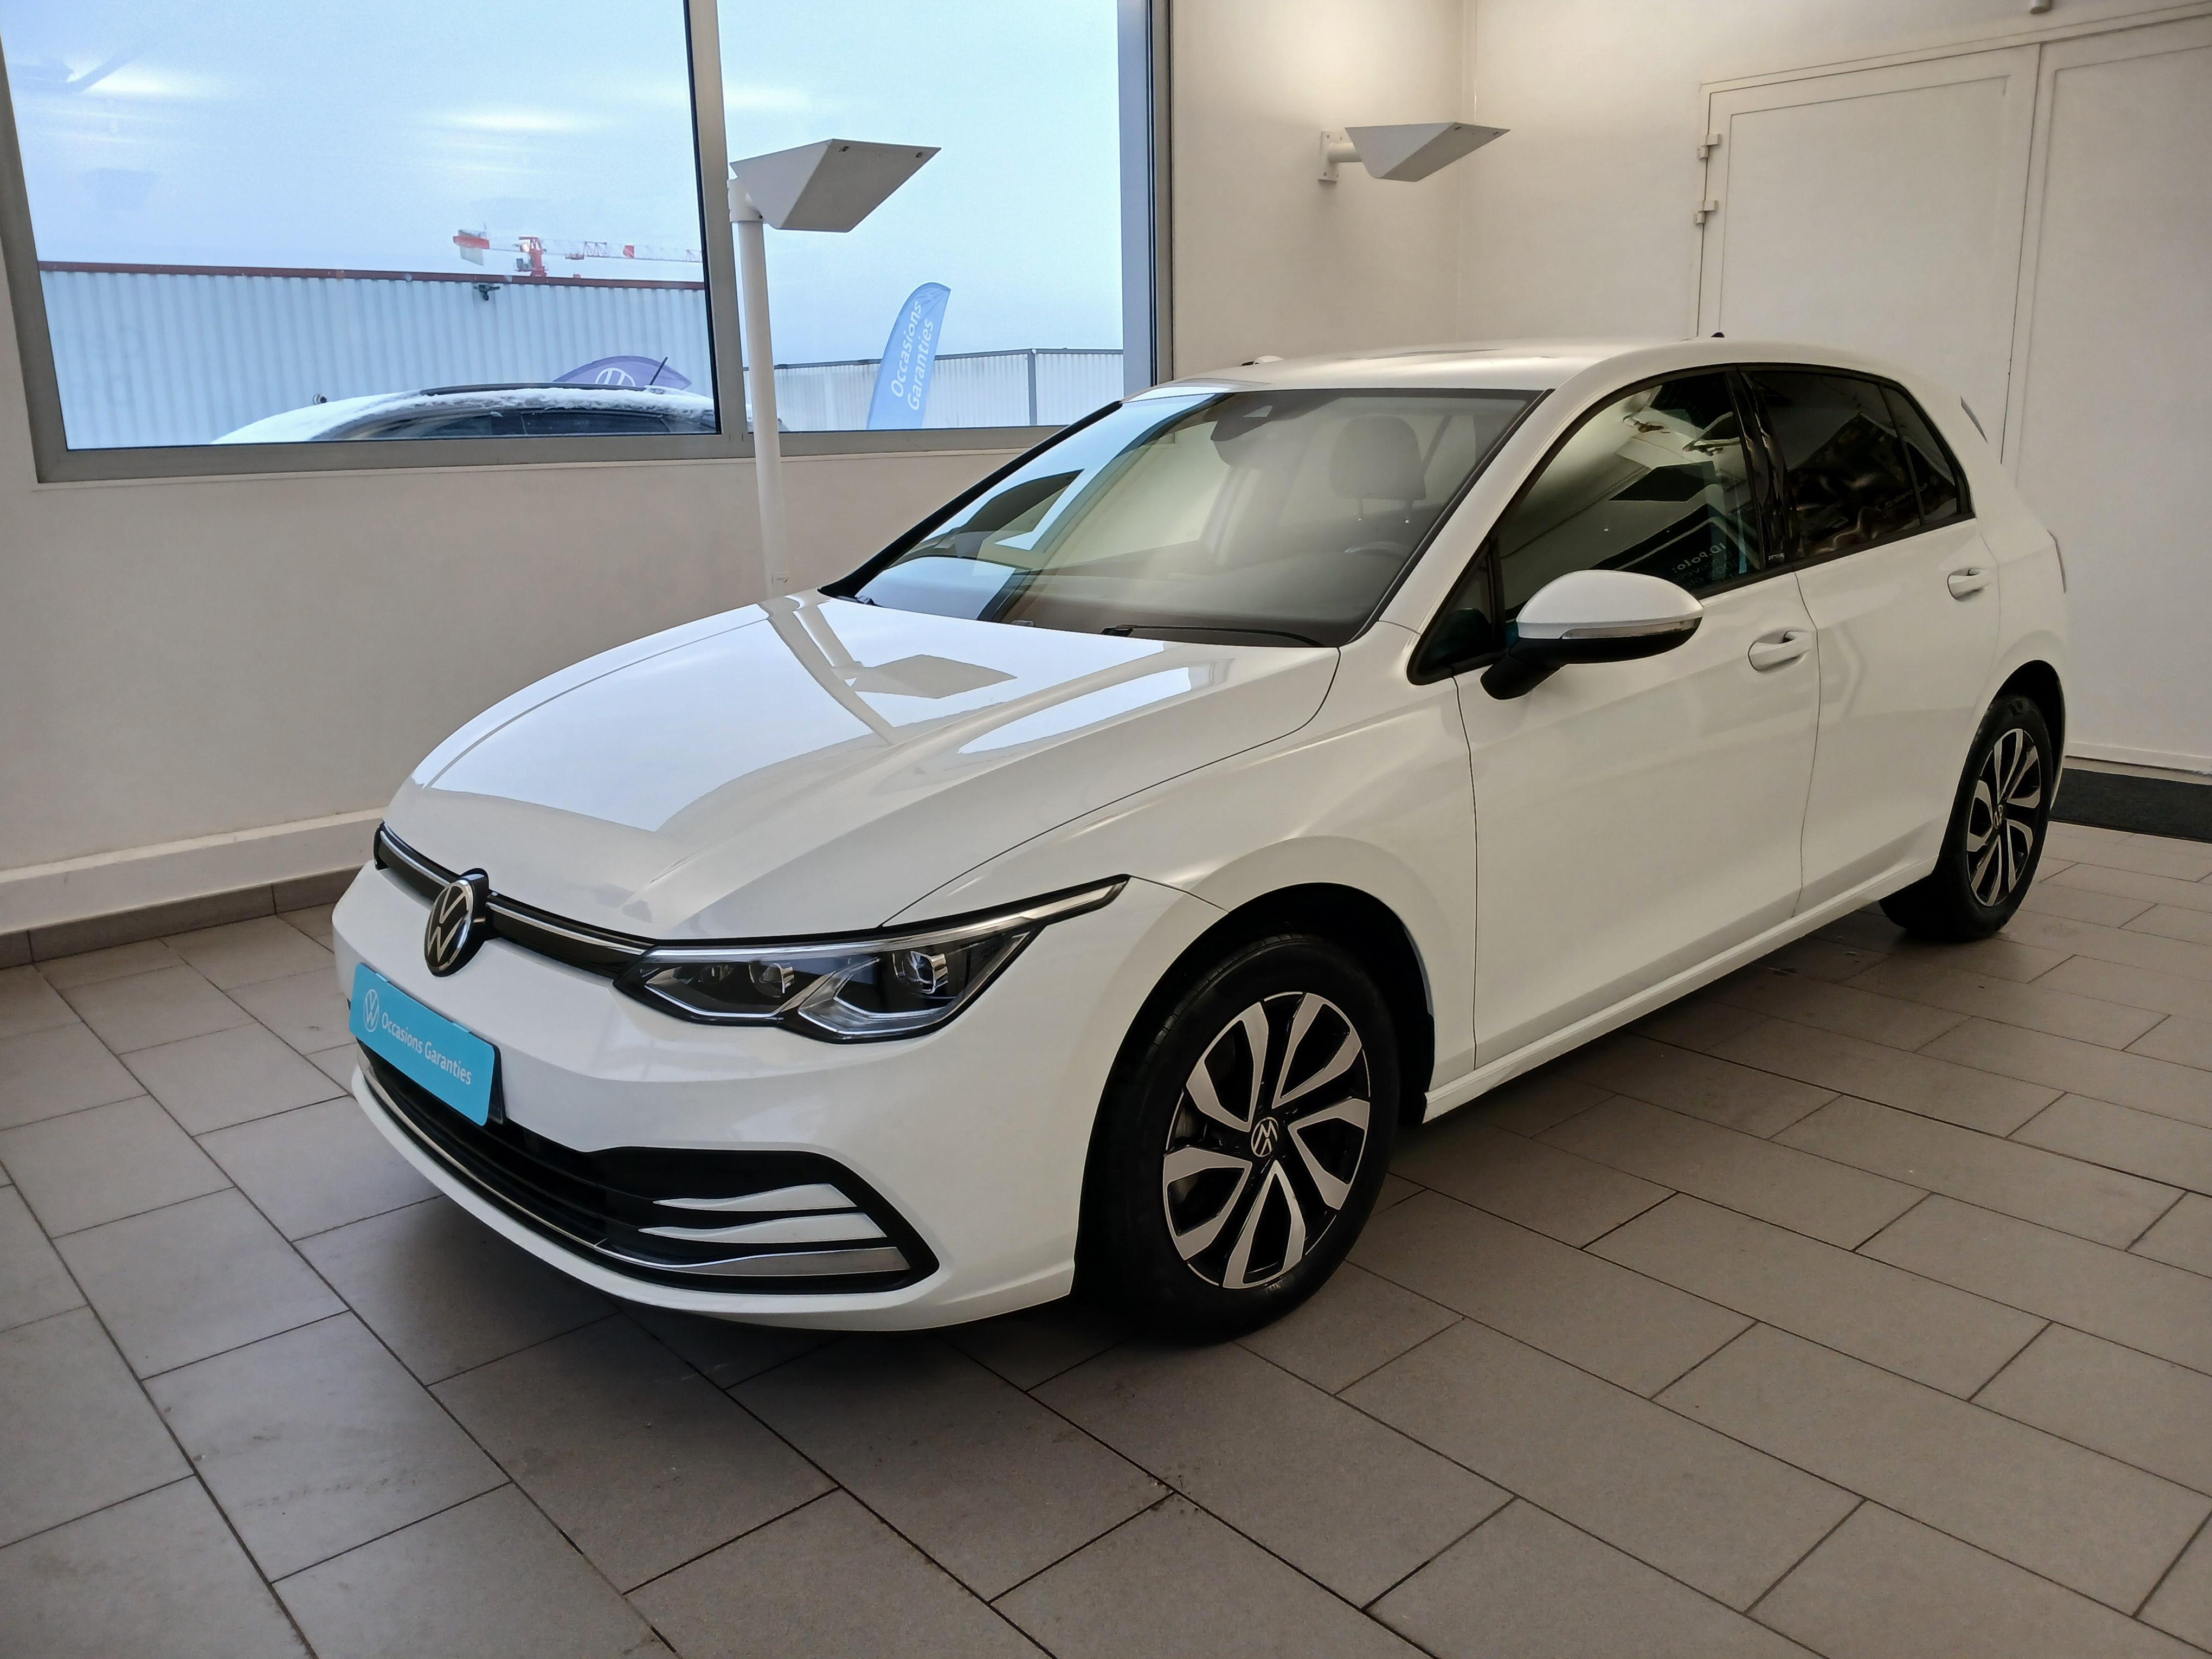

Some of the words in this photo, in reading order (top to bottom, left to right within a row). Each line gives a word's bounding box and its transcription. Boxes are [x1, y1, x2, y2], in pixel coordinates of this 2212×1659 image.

[891, 301, 921, 397] Occasions
[908, 319, 933, 410] Garanties
[364, 989, 380, 1032] VW
[382, 1012, 423, 1054] Occasions
[425, 1041, 472, 1085] Garanties
